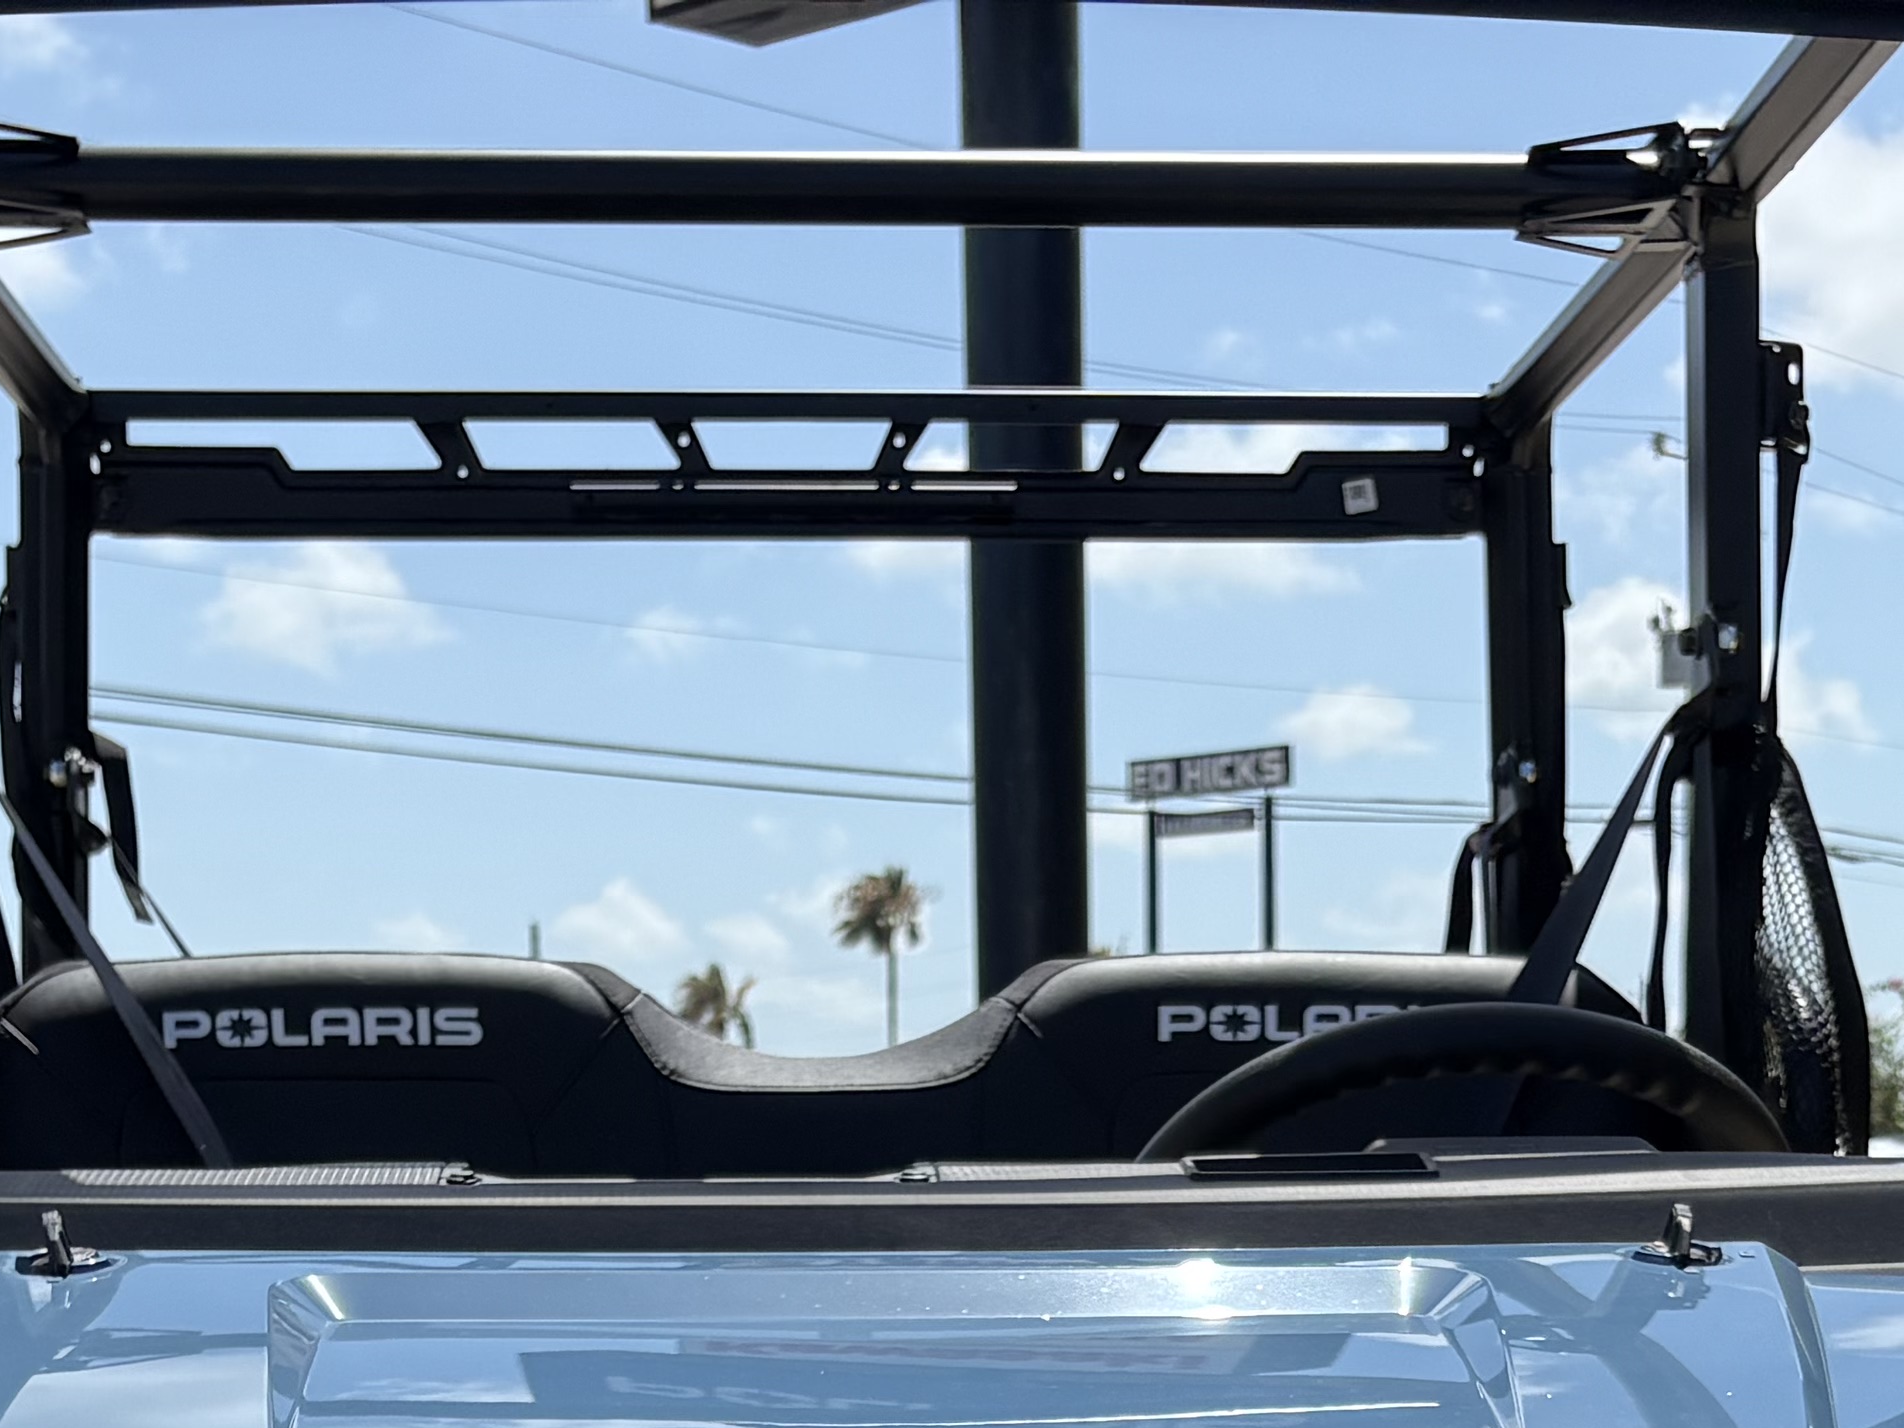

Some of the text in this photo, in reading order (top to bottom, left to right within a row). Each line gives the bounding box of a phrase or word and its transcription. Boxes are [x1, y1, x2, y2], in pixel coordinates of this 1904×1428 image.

[1133, 750, 1283, 796] ED HICKS
[162, 1006, 484, 1050] POLARIS
